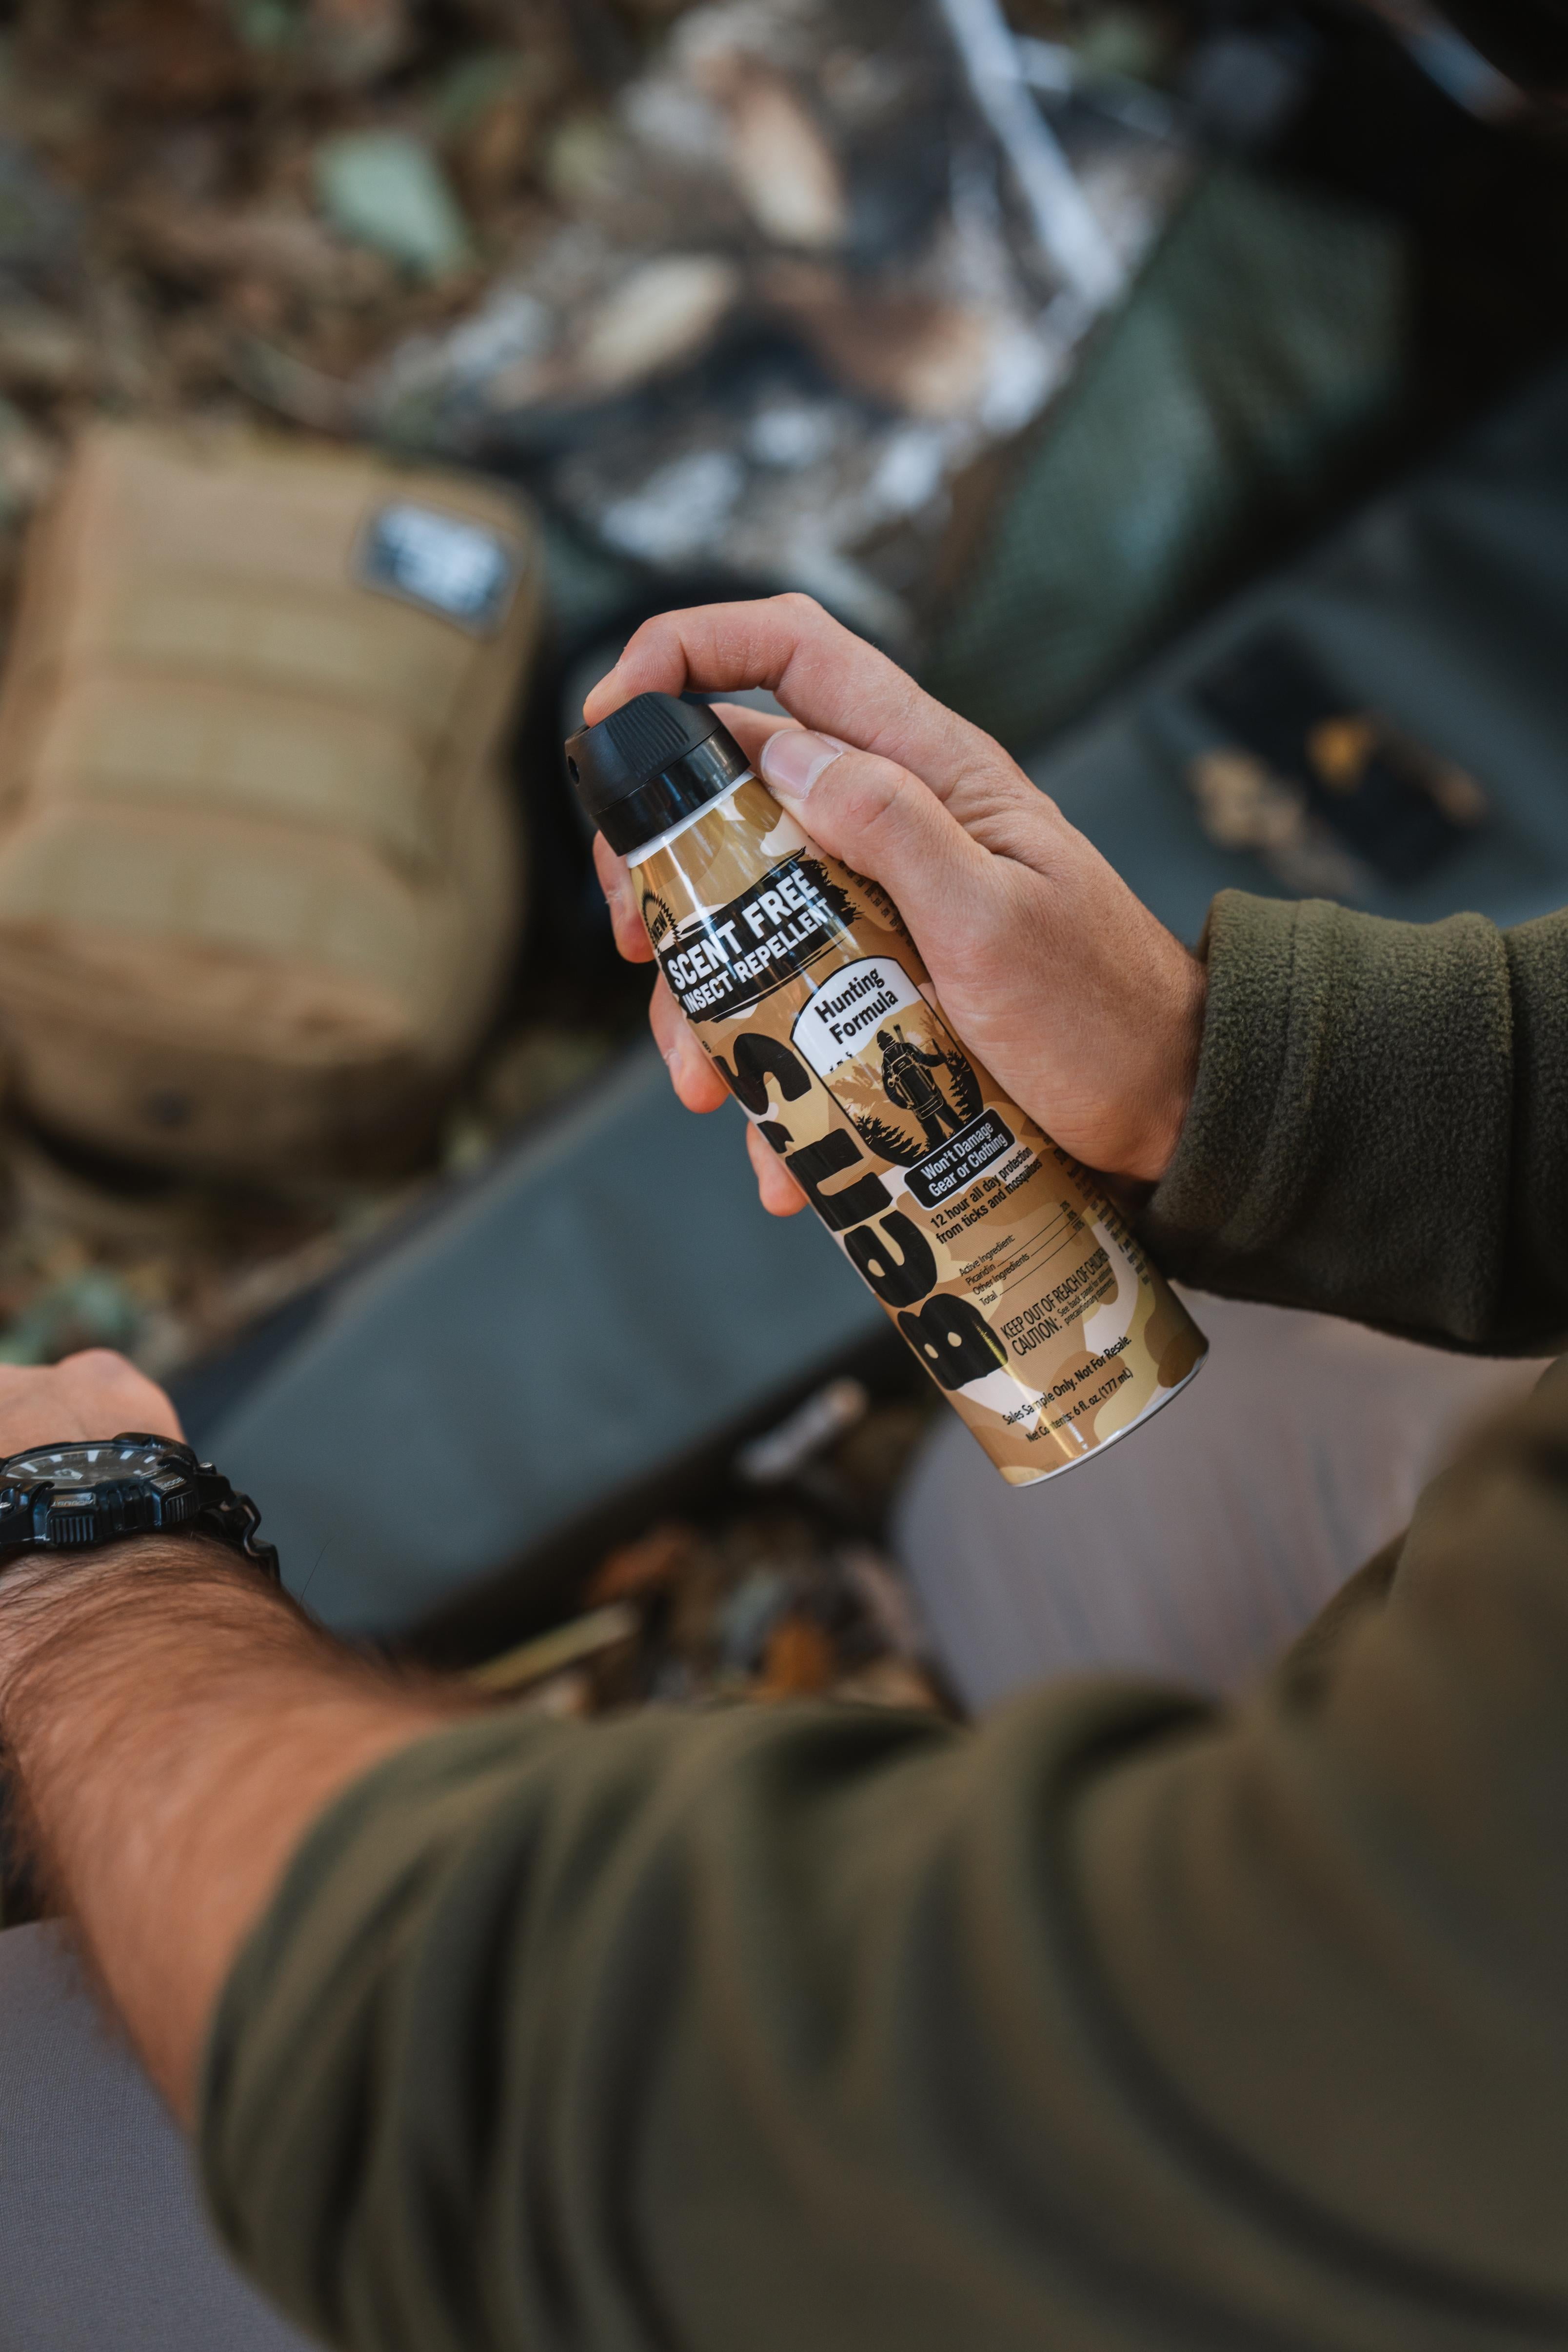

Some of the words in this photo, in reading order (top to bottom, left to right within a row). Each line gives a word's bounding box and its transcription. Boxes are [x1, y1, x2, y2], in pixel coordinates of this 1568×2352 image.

[668, 920, 742, 989] SCENT
[742, 869, 818, 938] FREE
[683, 971, 733, 1013] INSECT
[733, 898, 834, 983] REPELLENT
[814, 969, 885, 1023] Hunting
[829, 991, 898, 1044] Formula
[920, 1150, 957, 1180] Won't
[953, 1123, 993, 1157] Damage
[929, 1173, 957, 1196] Gear
[957, 1163, 970, 1177] or
[968, 1134, 1008, 1167] Clothing
[931, 1214, 948, 1228] 12
[944, 1198, 970, 1220] hour
[970, 1186, 984, 1202] all
[983, 1175, 1001, 1192] day
[998, 1147, 1033, 1181] protection
[936, 1223, 964, 1244] from
[961, 1205, 989, 1227] ticks
[988, 1188, 1007, 1209] and
[1004, 1159, 1042, 1195] mosquitoes
[959, 1260, 980, 1276] Active
[978, 1235, 1015, 1266] Ingredient:
[965, 1264, 996, 1286] Picaridin
[973, 1279, 993, 1295] Other
[992, 1254, 1030, 1282] Ingredients
[979, 1291, 998, 1305] Total
[1000, 1316, 1024, 1340] KEEP
[1023, 1303, 1045, 1325] OUT
[1041, 1294, 1055, 1312] OF
[1052, 1275, 1082, 1303] REACH
[1076, 1266, 1090, 1283] OF
[1057, 1306, 1070, 1317] See
[1067, 1295, 1082, 1309] back
[1081, 1283, 1094, 1300] panel
[1064, 1295, 1098, 1326] precautionary
[1012, 1316, 1062, 1355] CAUTION:
[1002, 1410, 1024, 1425] Sales
[1022, 1393, 1055, 1415] Sample
[1053, 1379, 1077, 1396] Only.
[1074, 1365, 1093, 1382] Not
[1090, 1355, 1106, 1371] For
[1103, 1336, 1131, 1360] Resale.
[1026, 1431, 1041, 1442] Net
[1073, 1406, 1080, 1415] 6
[1078, 1400, 1090, 1411] fl.
[1089, 1395, 1101, 1405] oz.
[1098, 1378, 1117, 1399] (177
[1117, 1368, 1133, 1384] mL)
